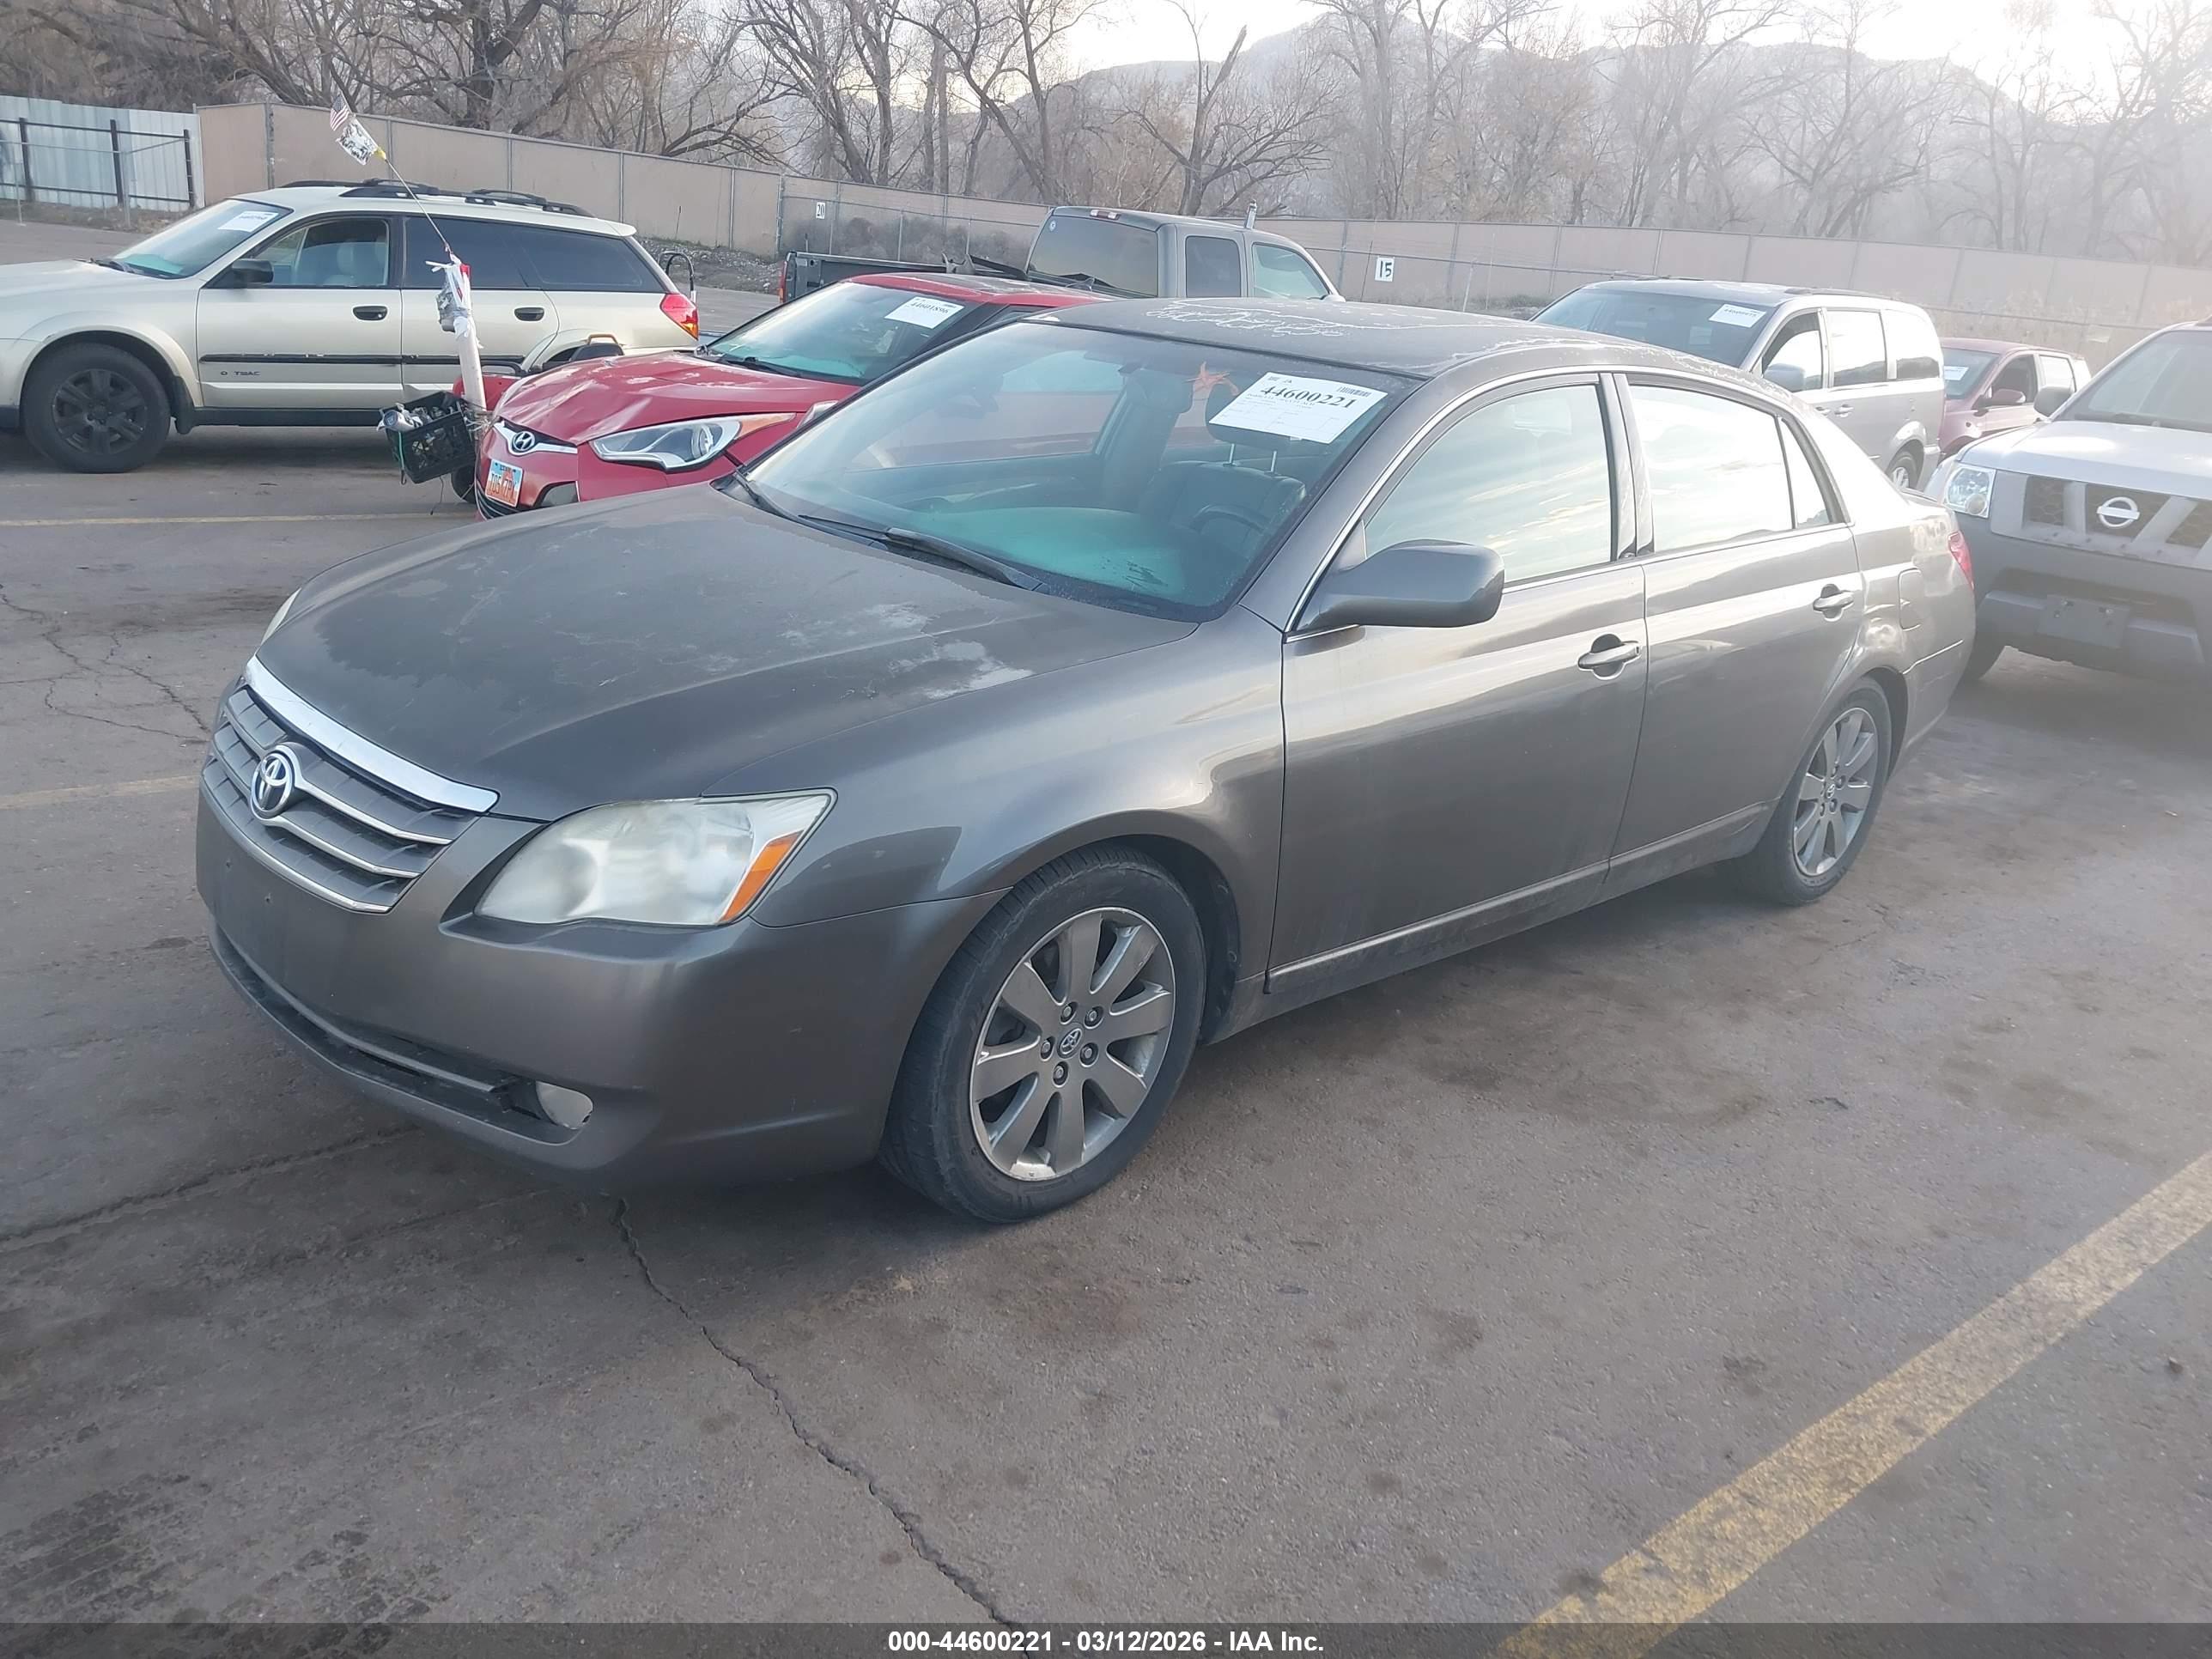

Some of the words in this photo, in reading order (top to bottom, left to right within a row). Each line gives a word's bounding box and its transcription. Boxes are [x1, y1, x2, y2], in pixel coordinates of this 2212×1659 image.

[817, 204, 825, 217] 20
[1380, 260, 1392, 278] 15
[1261, 386, 1357, 409] 44600221
